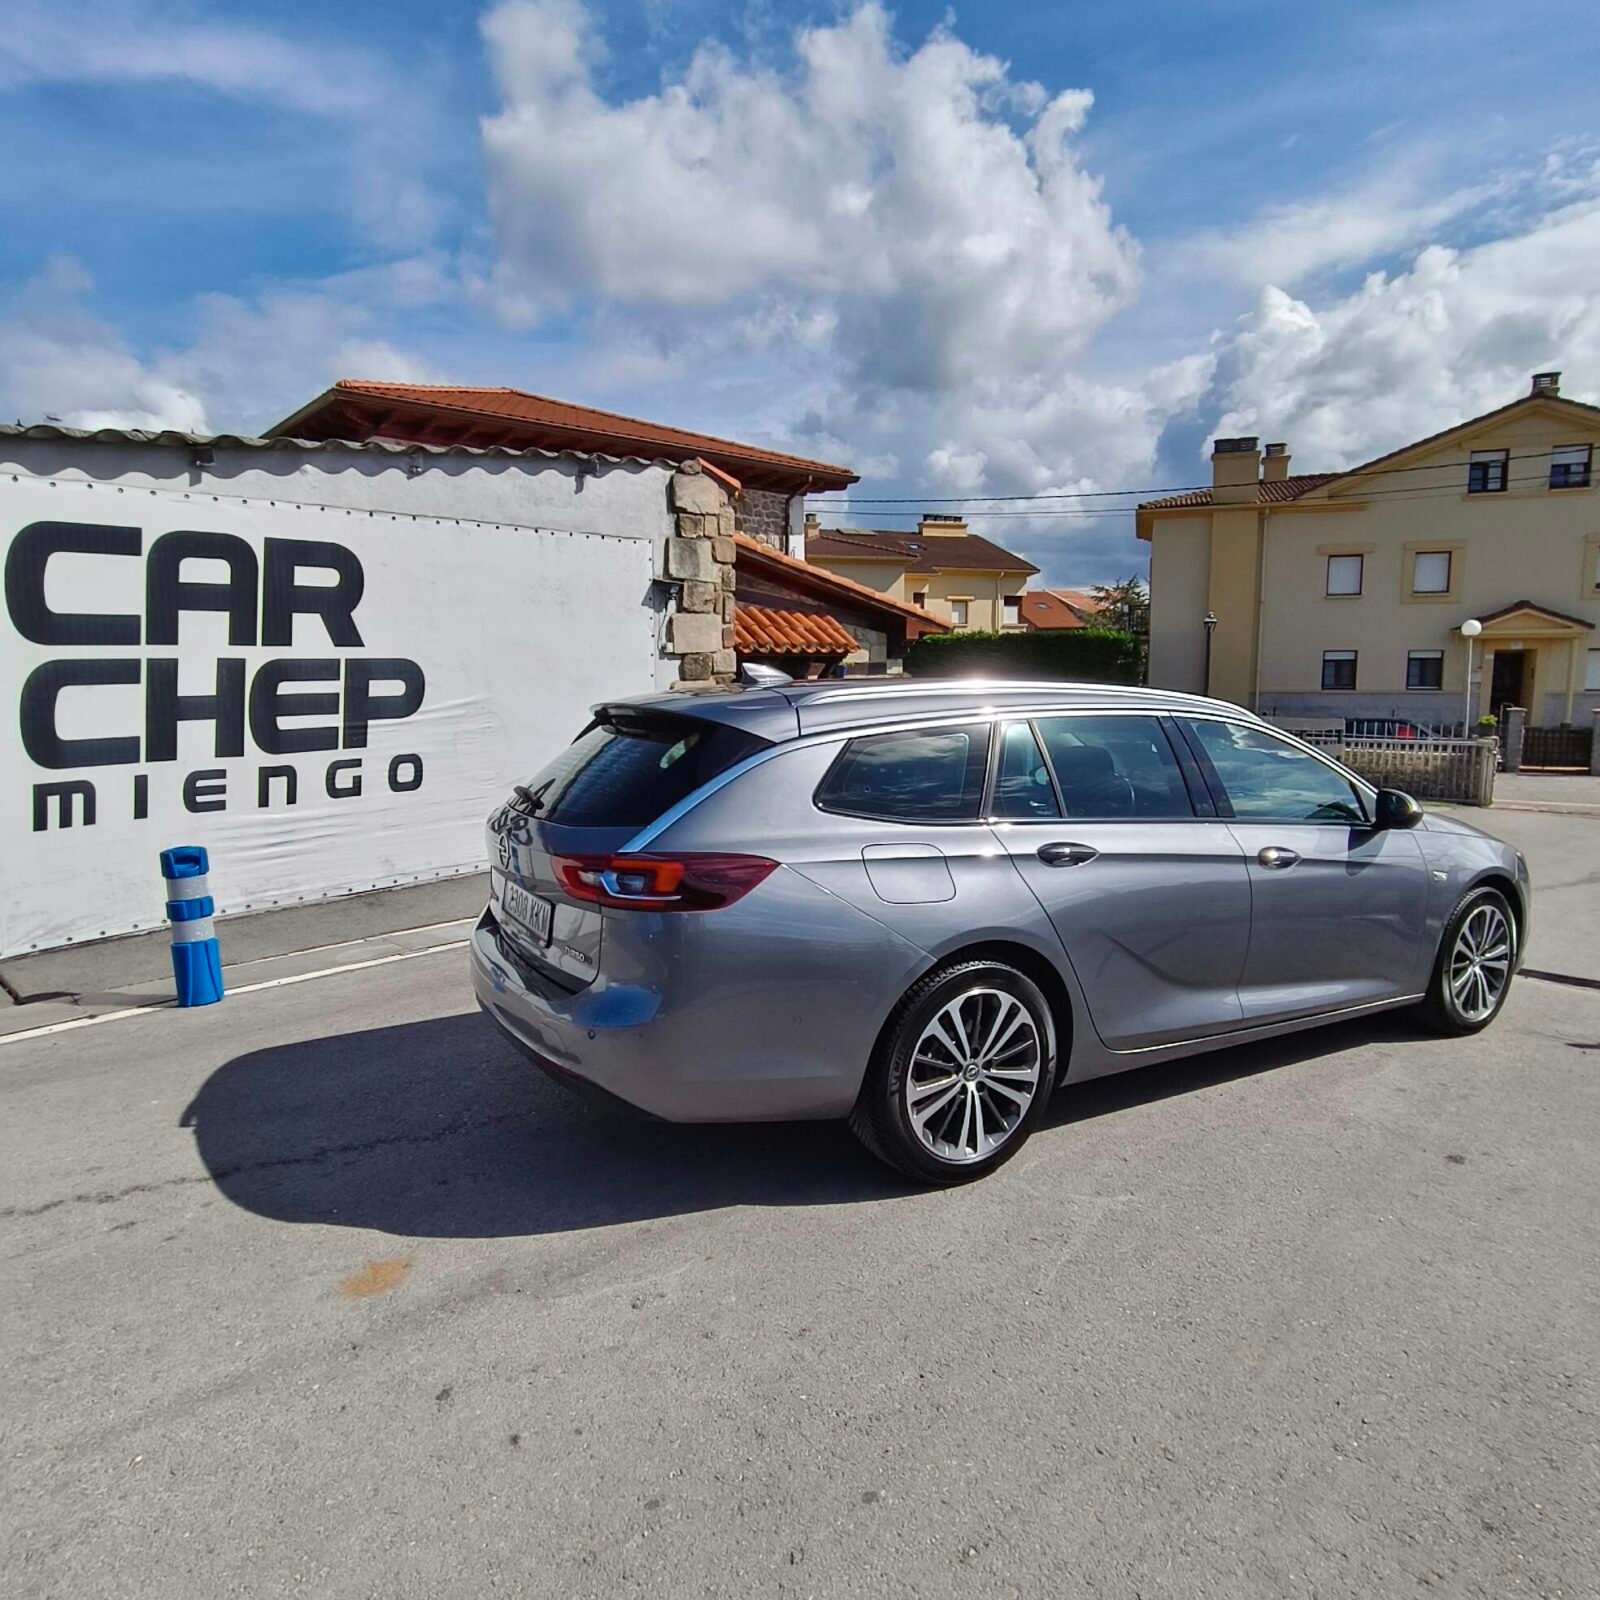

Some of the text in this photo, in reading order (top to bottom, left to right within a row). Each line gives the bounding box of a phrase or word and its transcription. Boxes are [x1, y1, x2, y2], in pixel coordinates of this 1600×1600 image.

[5, 521, 364, 648] CAR
[20, 658, 425, 770] CHEP
[33, 754, 423, 832] MIENGO
